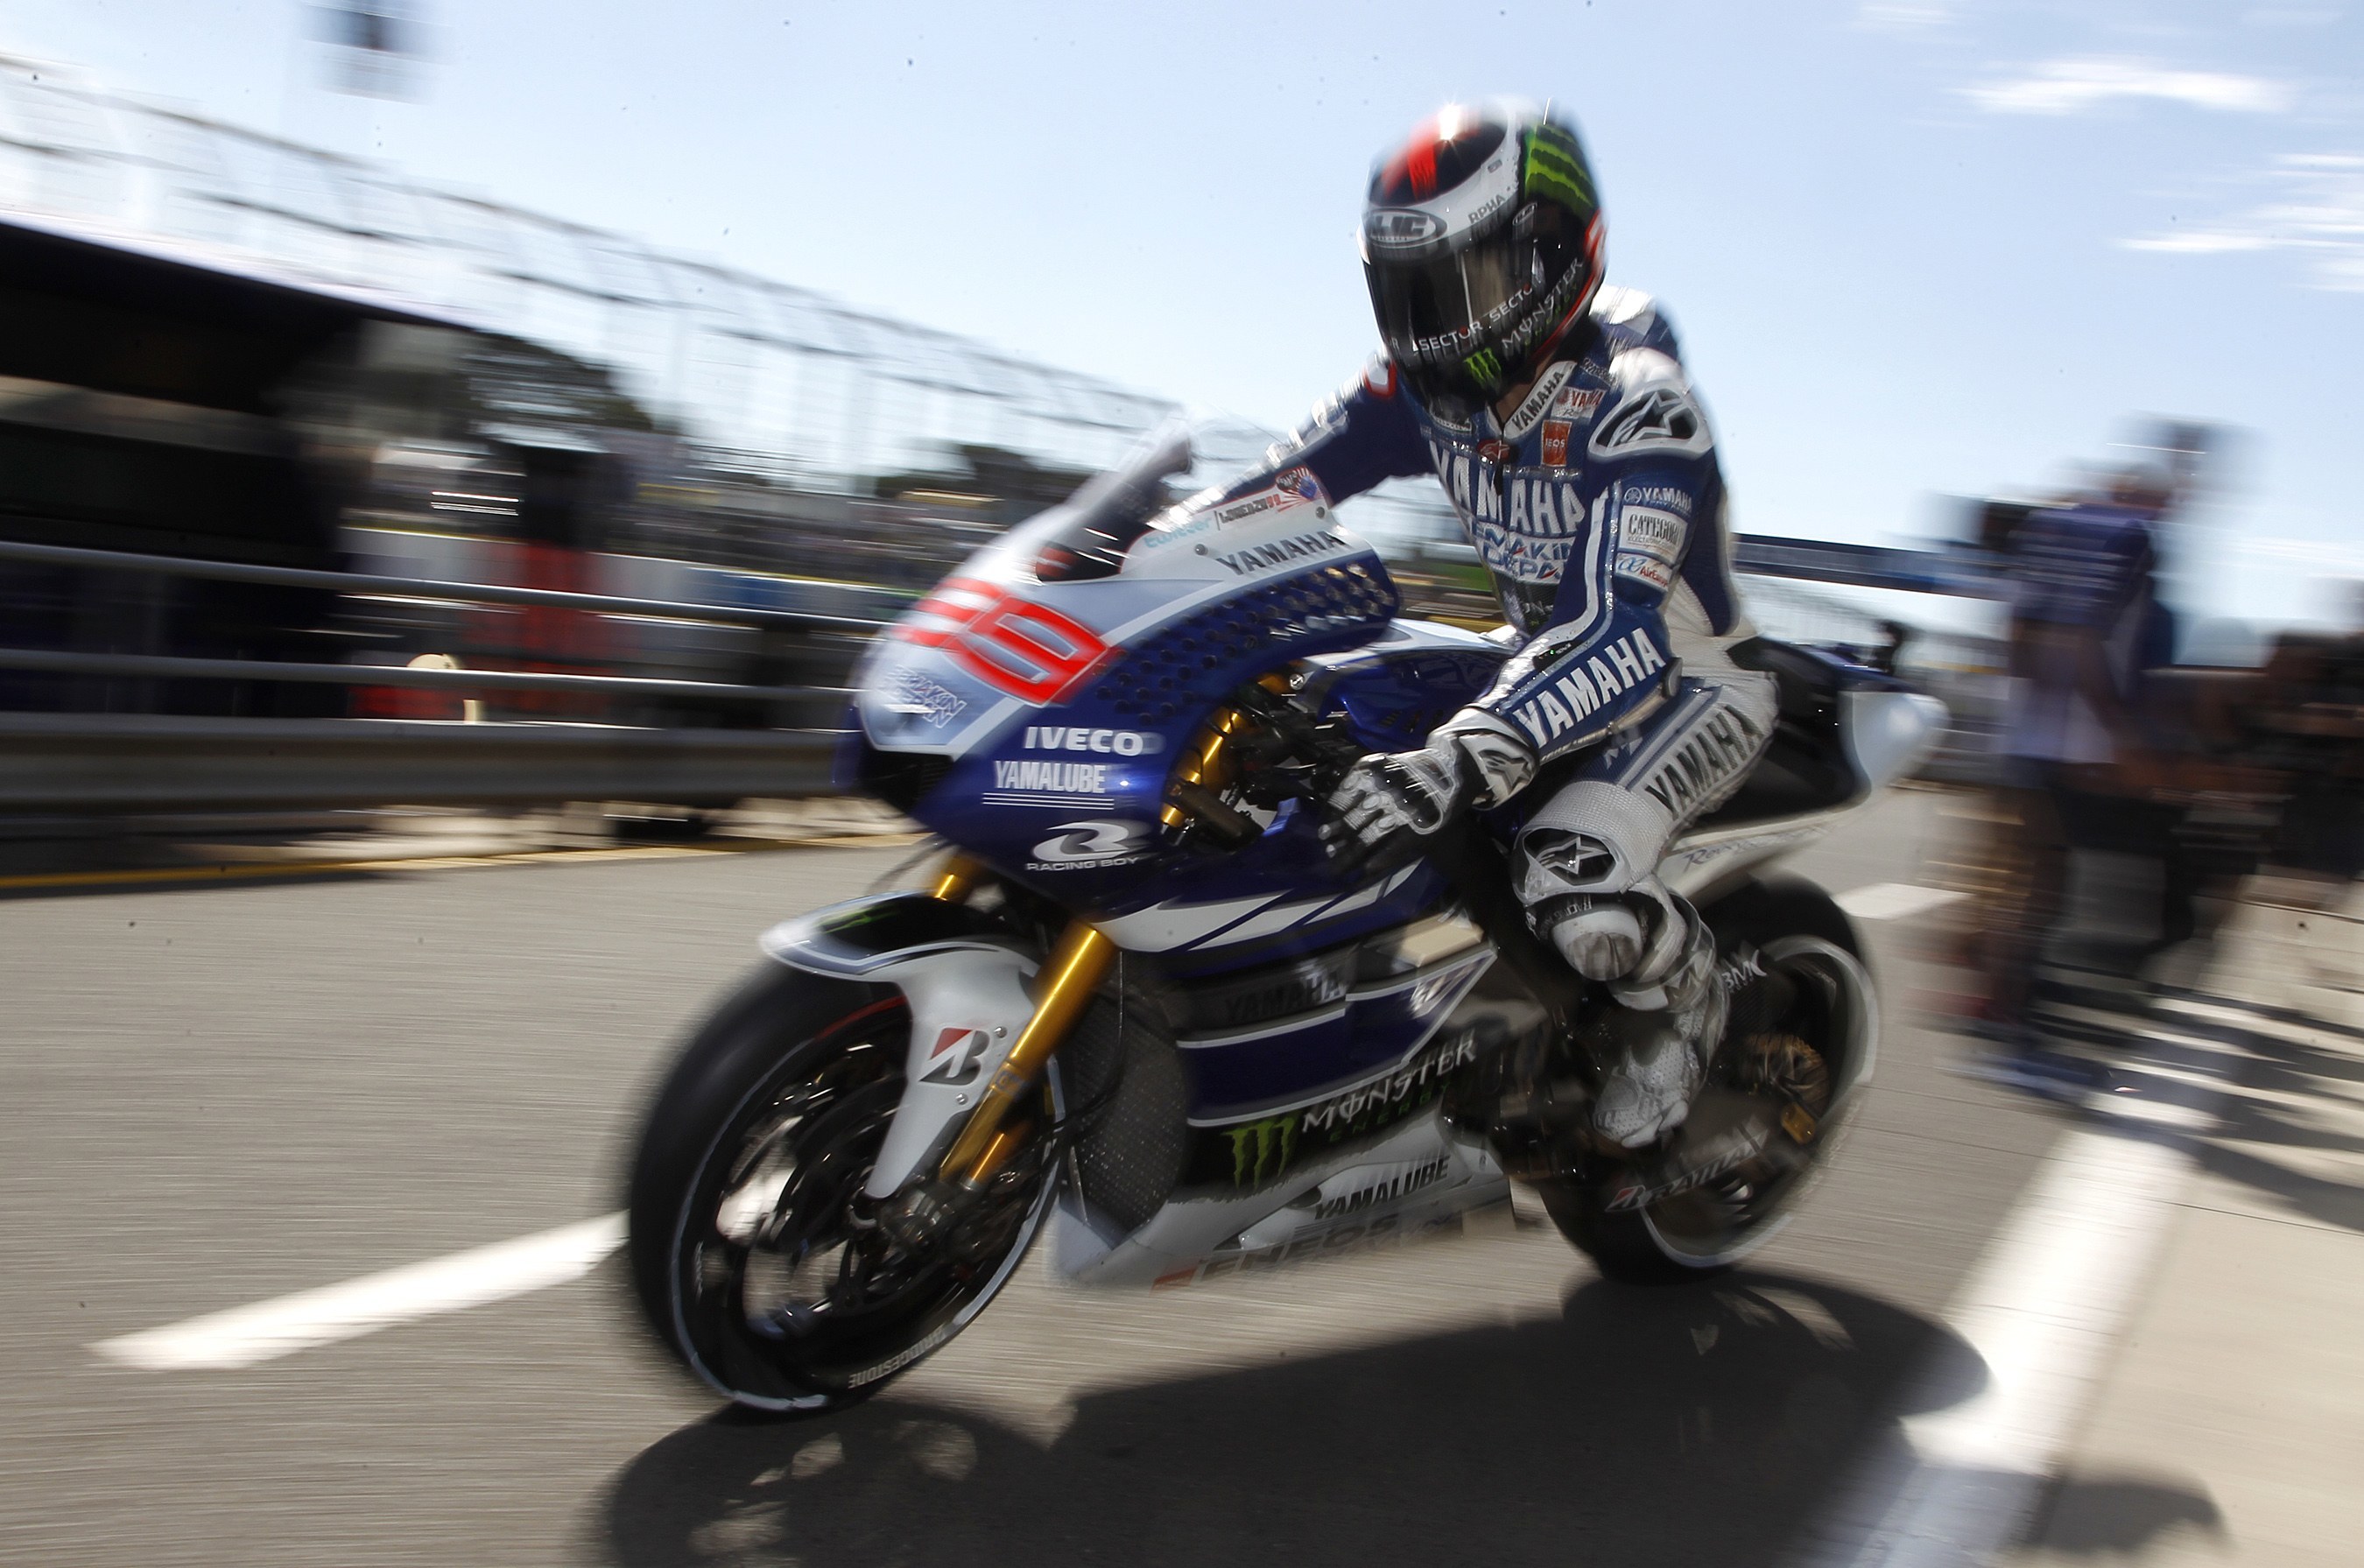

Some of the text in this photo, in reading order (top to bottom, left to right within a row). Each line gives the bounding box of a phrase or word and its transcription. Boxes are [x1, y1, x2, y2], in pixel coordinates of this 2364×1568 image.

[1512, 370, 1565, 431] YAMAHA
[1643, 487, 1692, 514] YAMAHA
[1216, 531, 1349, 575] YAMAHA
[1512, 628, 1666, 748] YAMAHA
[1024, 727, 1145, 756] IVECO
[1645, 704, 1764, 820] YAMAHA
[995, 760, 1107, 793] YAMALUBE
[1024, 857, 1139, 871] RACING BOY
[1302, 1036, 1476, 1133] MONSTER
[1314, 1156, 1452, 1220] YAMALUBE
